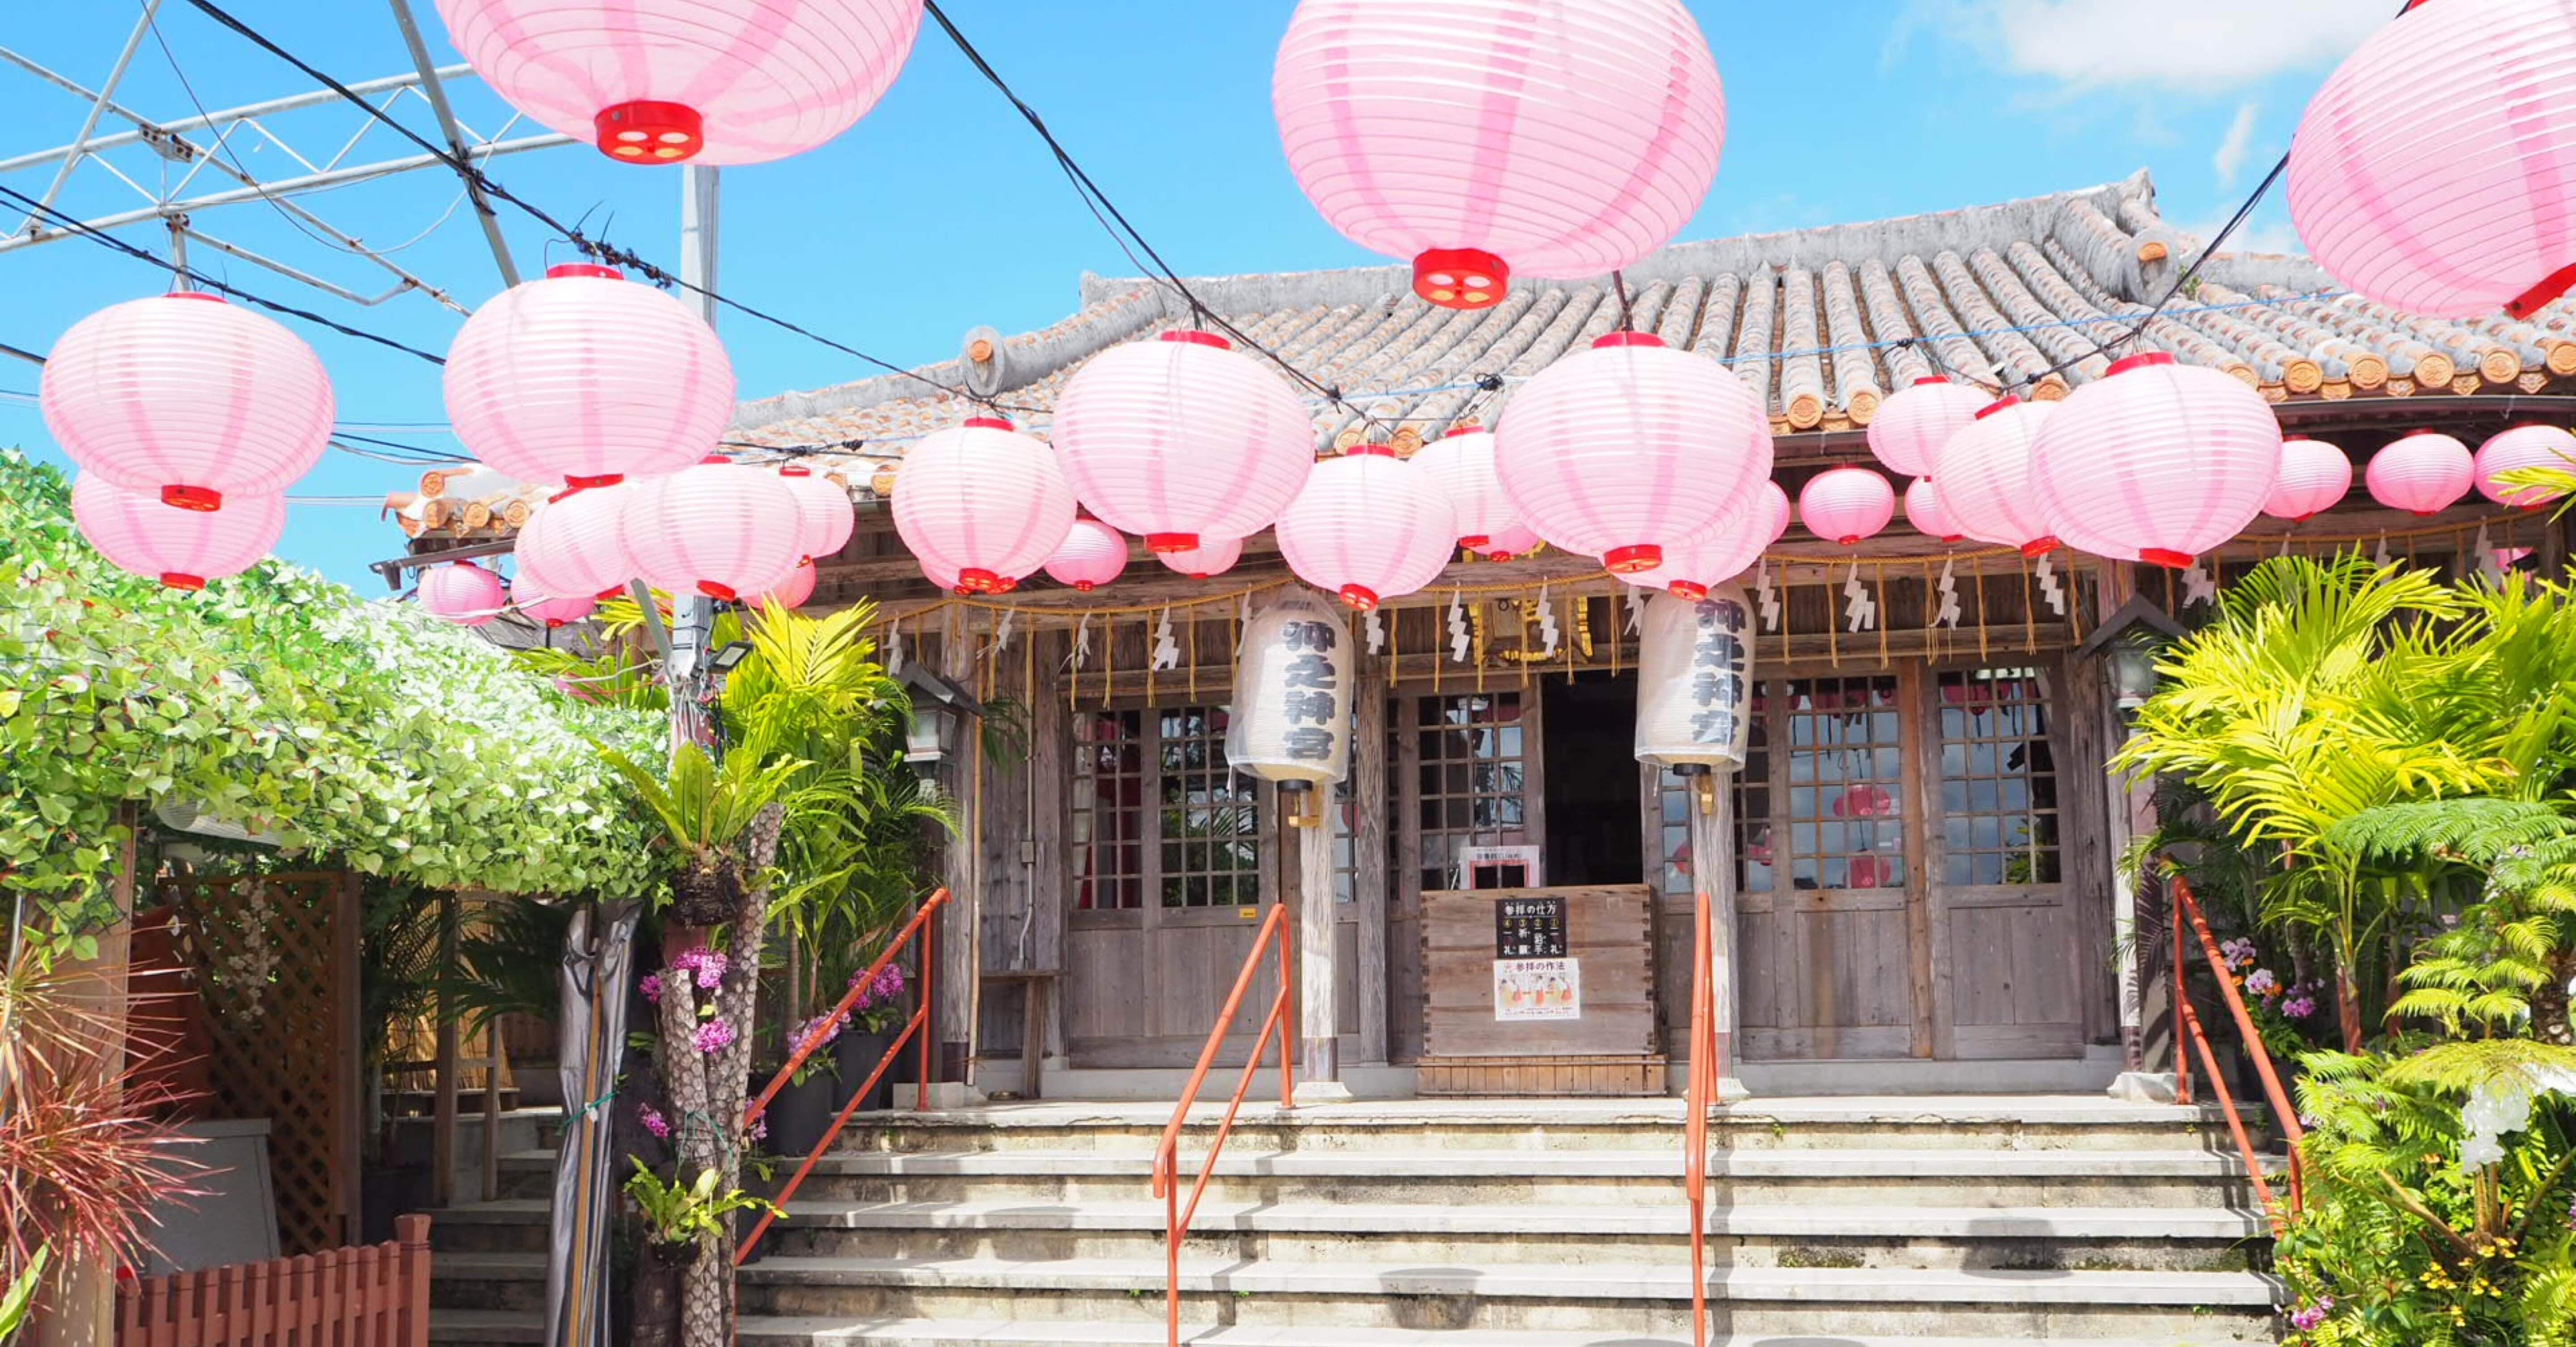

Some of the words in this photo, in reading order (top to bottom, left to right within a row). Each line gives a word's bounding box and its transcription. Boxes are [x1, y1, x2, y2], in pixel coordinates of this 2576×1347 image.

[1505, 904, 1557, 915] 参拝の仕方
[1517, 962, 1565, 971] 参拝の作法
